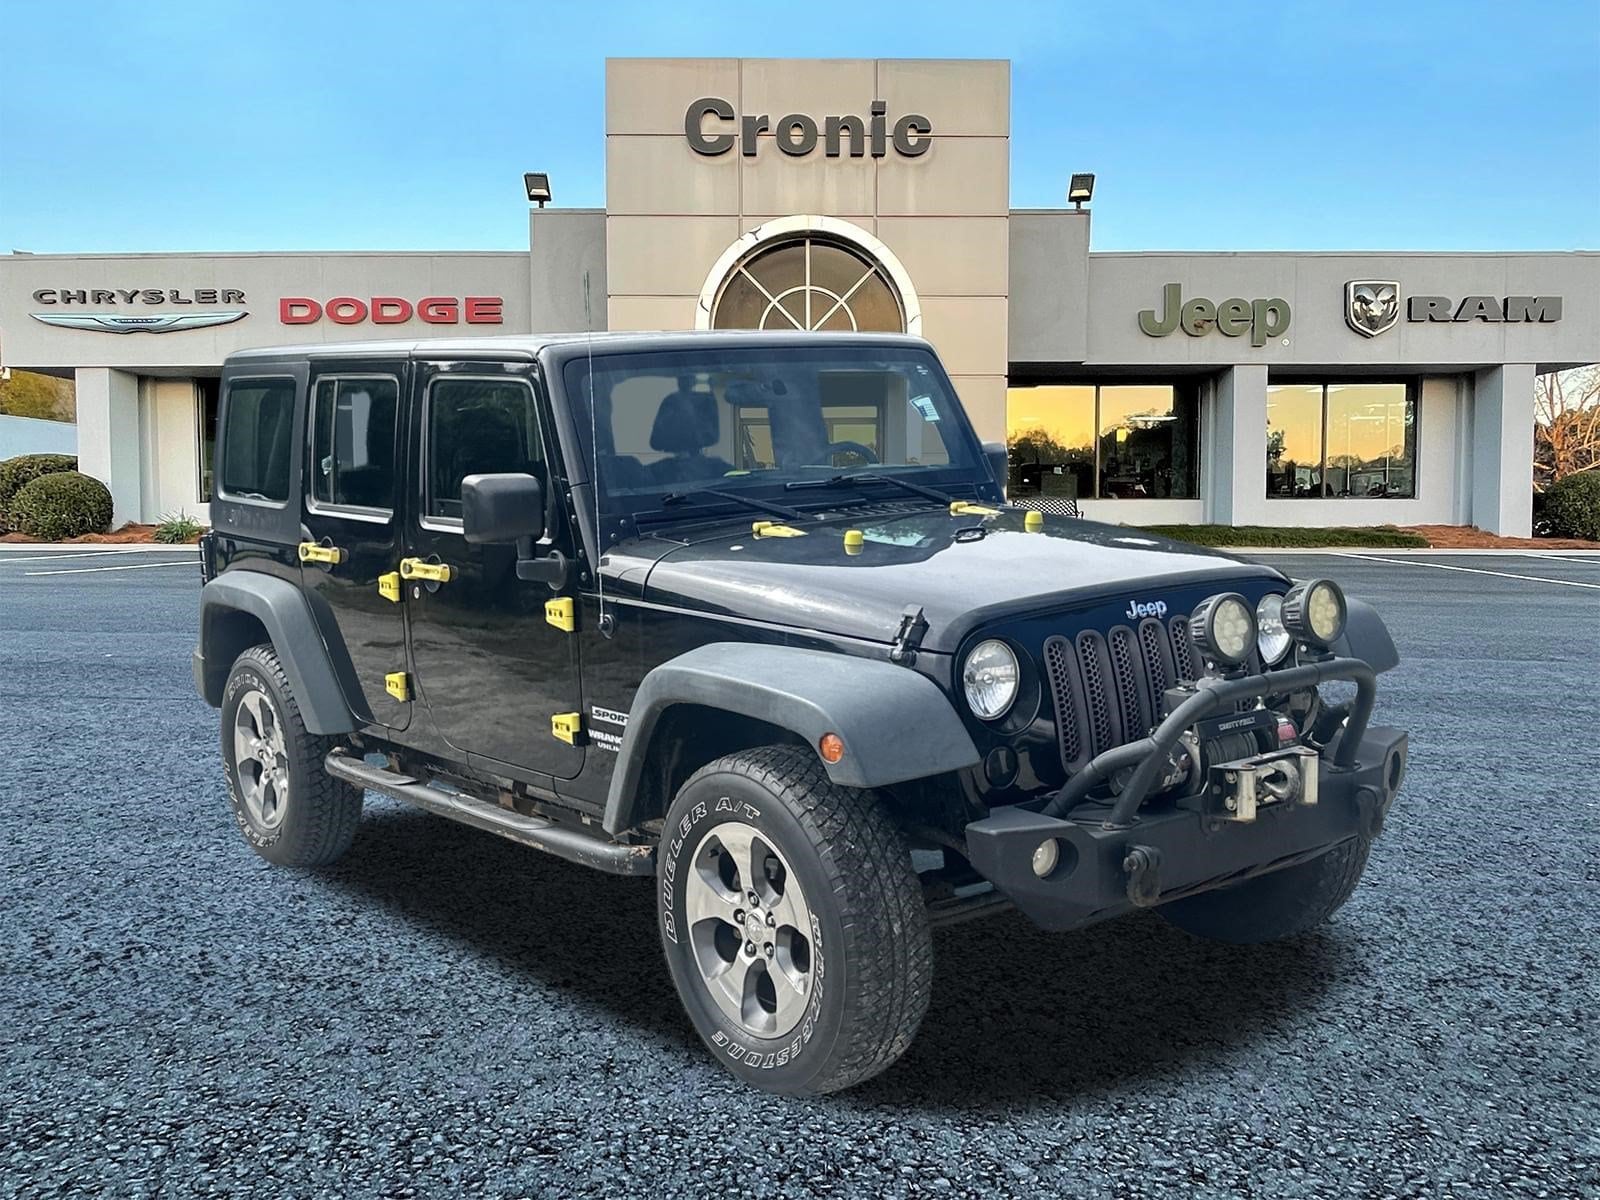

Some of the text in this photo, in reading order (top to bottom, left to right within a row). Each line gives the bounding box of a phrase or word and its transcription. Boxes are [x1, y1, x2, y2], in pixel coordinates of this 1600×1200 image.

[684, 97, 932, 157] Cronic
[32, 289, 246, 304] CHRYSLER
[1407, 295, 1563, 323] RAM
[279, 297, 503, 325] DODGE
[1138, 283, 1291, 347] Jeep
[1126, 600, 1167, 619] Jeep
[663, 797, 760, 943] DUELER A/T
